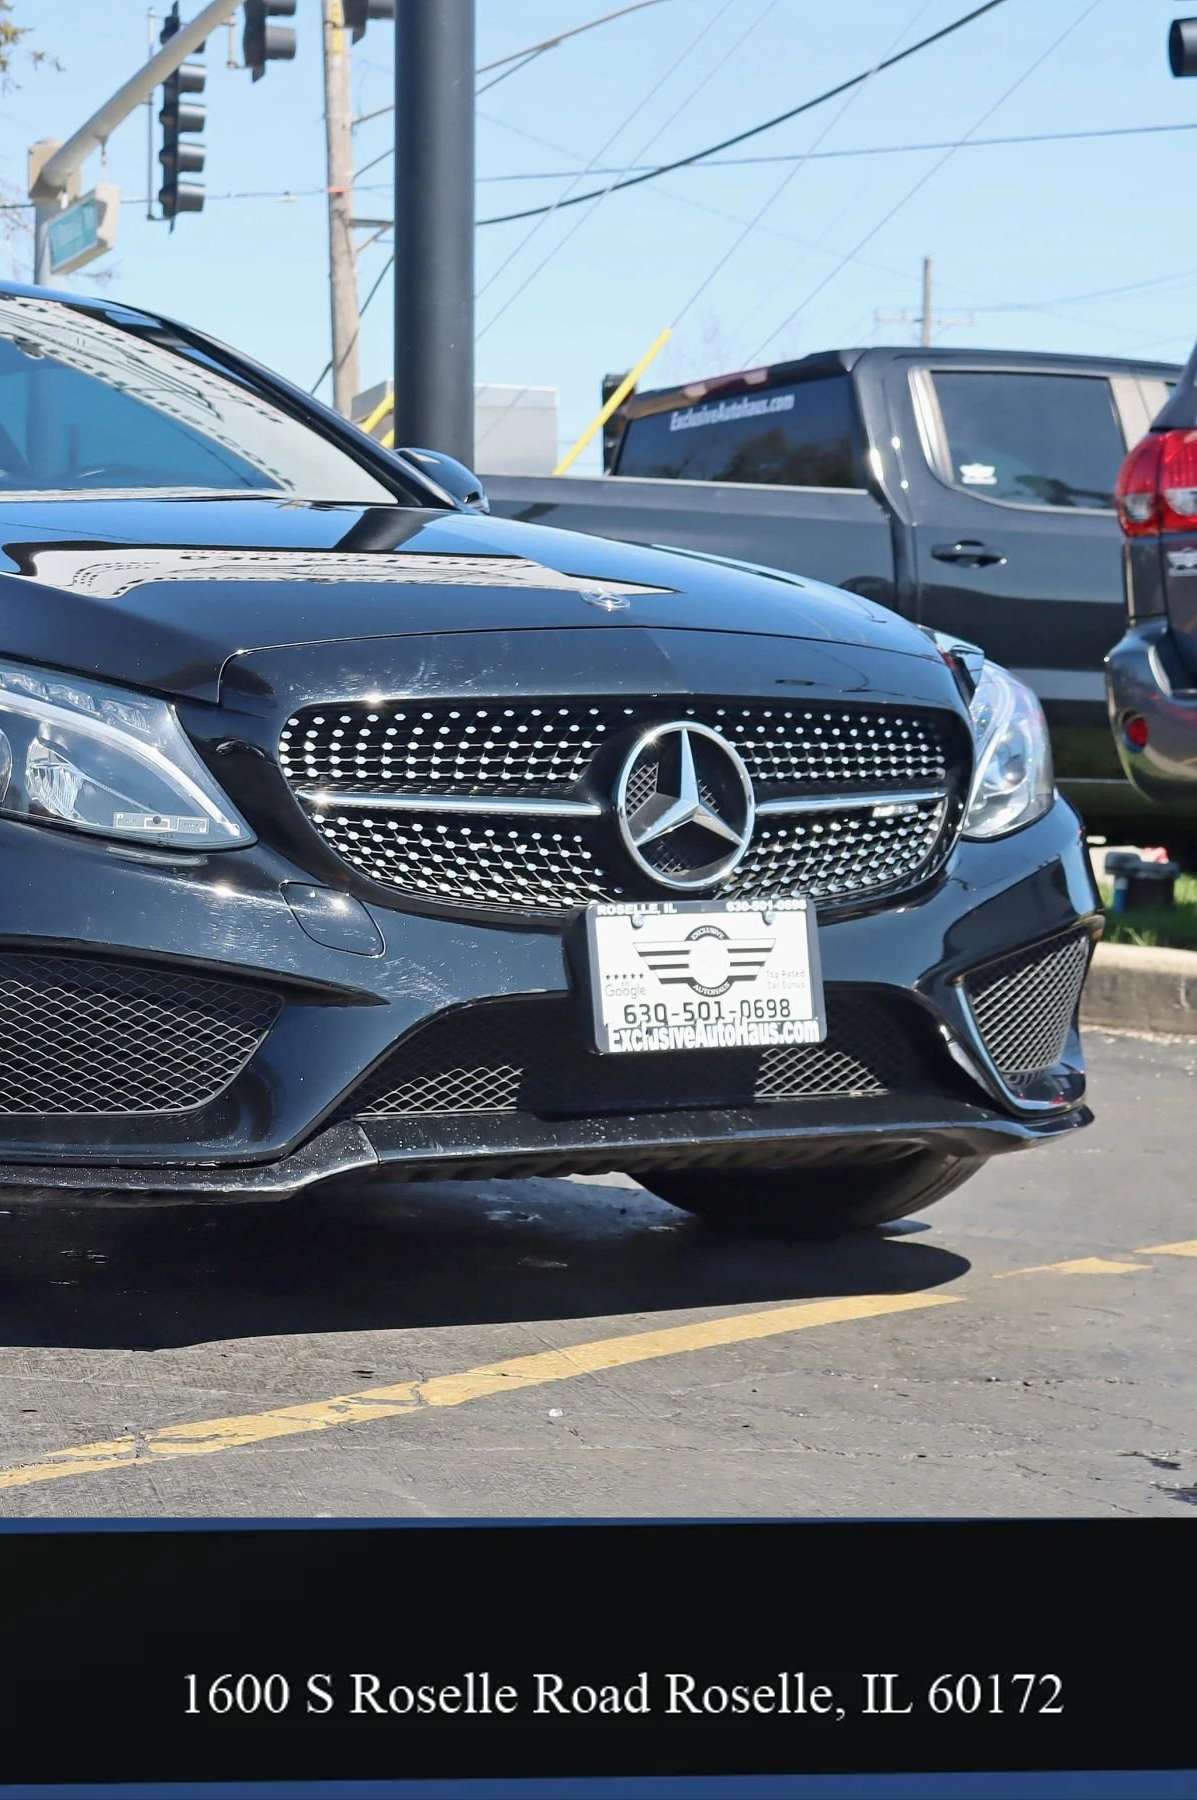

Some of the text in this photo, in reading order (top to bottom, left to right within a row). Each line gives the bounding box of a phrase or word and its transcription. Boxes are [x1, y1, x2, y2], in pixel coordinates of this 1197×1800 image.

[670, 394, 795, 432] ExclusiveAutohaus.com
[663, 902, 677, 914] IL
[605, 984, 647, 999] Google
[623, 998, 791, 1024] 630-501-0698
[607, 1016, 821, 1052] ExclusiveAutoHaus.com
